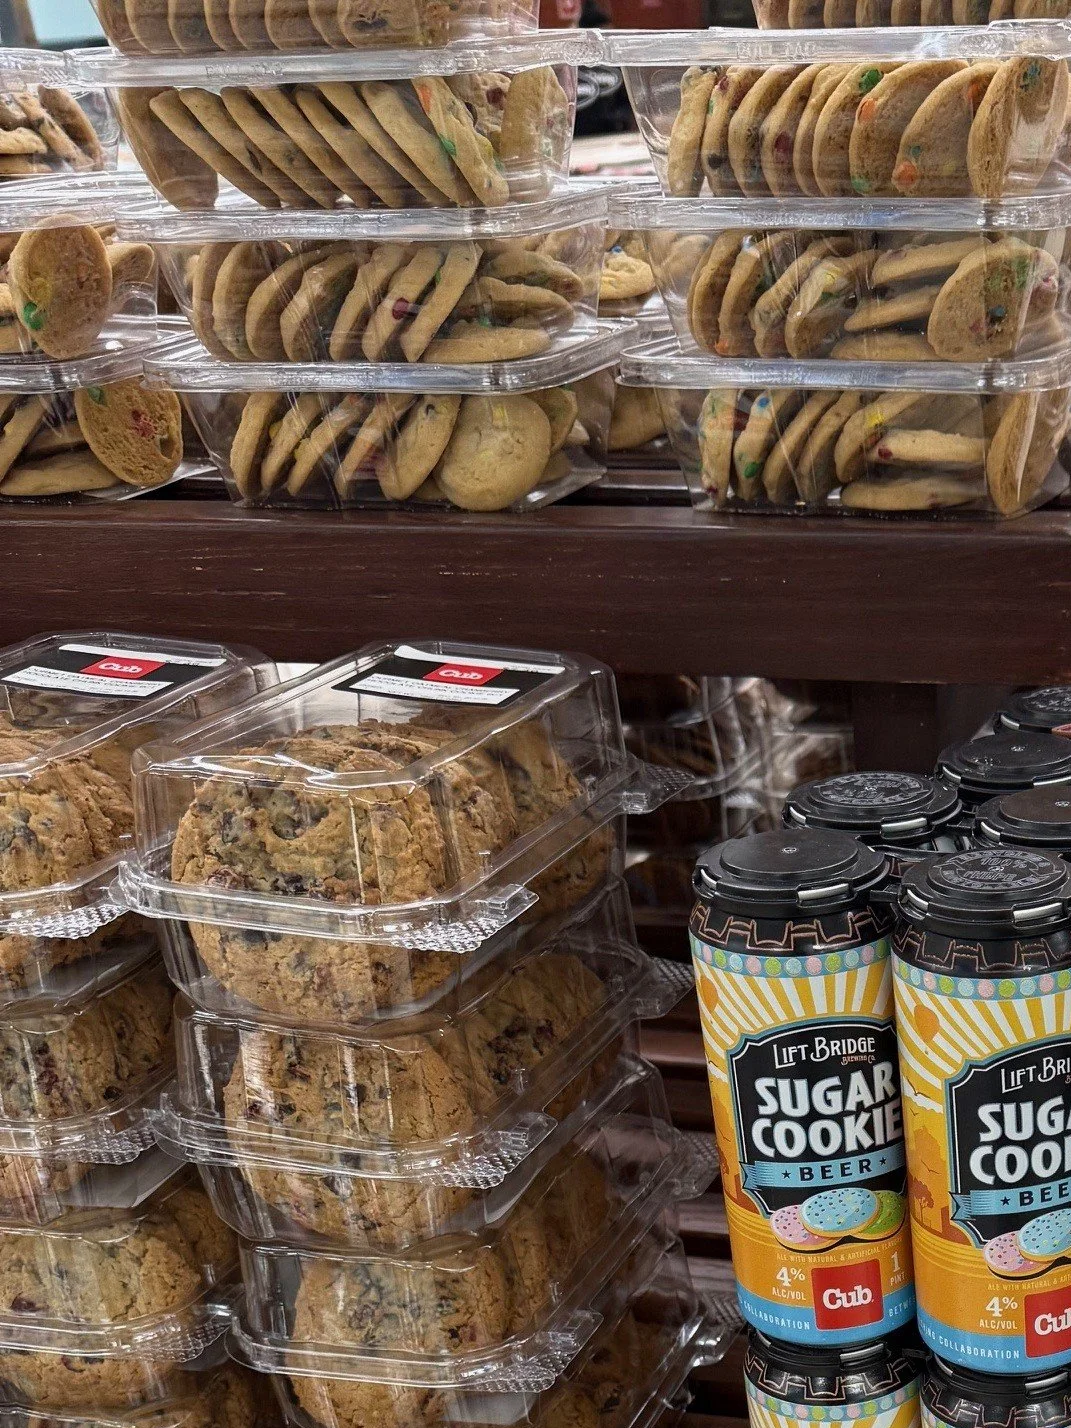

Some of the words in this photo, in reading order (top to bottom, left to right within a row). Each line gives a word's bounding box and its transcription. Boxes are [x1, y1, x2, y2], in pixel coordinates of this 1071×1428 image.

[98, 663, 142, 673] Cub
[438, 669, 483, 680] Cub
[773, 1043, 809, 1069] LIFT
[810, 1036, 876, 1062] BRIDGE
[754, 1061, 897, 1118] SUGAR
[1001, 1065, 1037, 1094] LIFT
[751, 1098, 904, 1158] COOKIE
[800, 1158, 872, 1182] BEER
[891, 1251, 900, 1273] 1
[776, 1266, 806, 1287] 4%
[772, 1287, 806, 1301] ALC/VOL
[822, 1285, 873, 1310] Cub
[985, 1296, 1018, 1317] 4%
[979, 1318, 1018, 1330] ALC/VOL
[939, 1336, 1020, 1359] COLLABORATION
